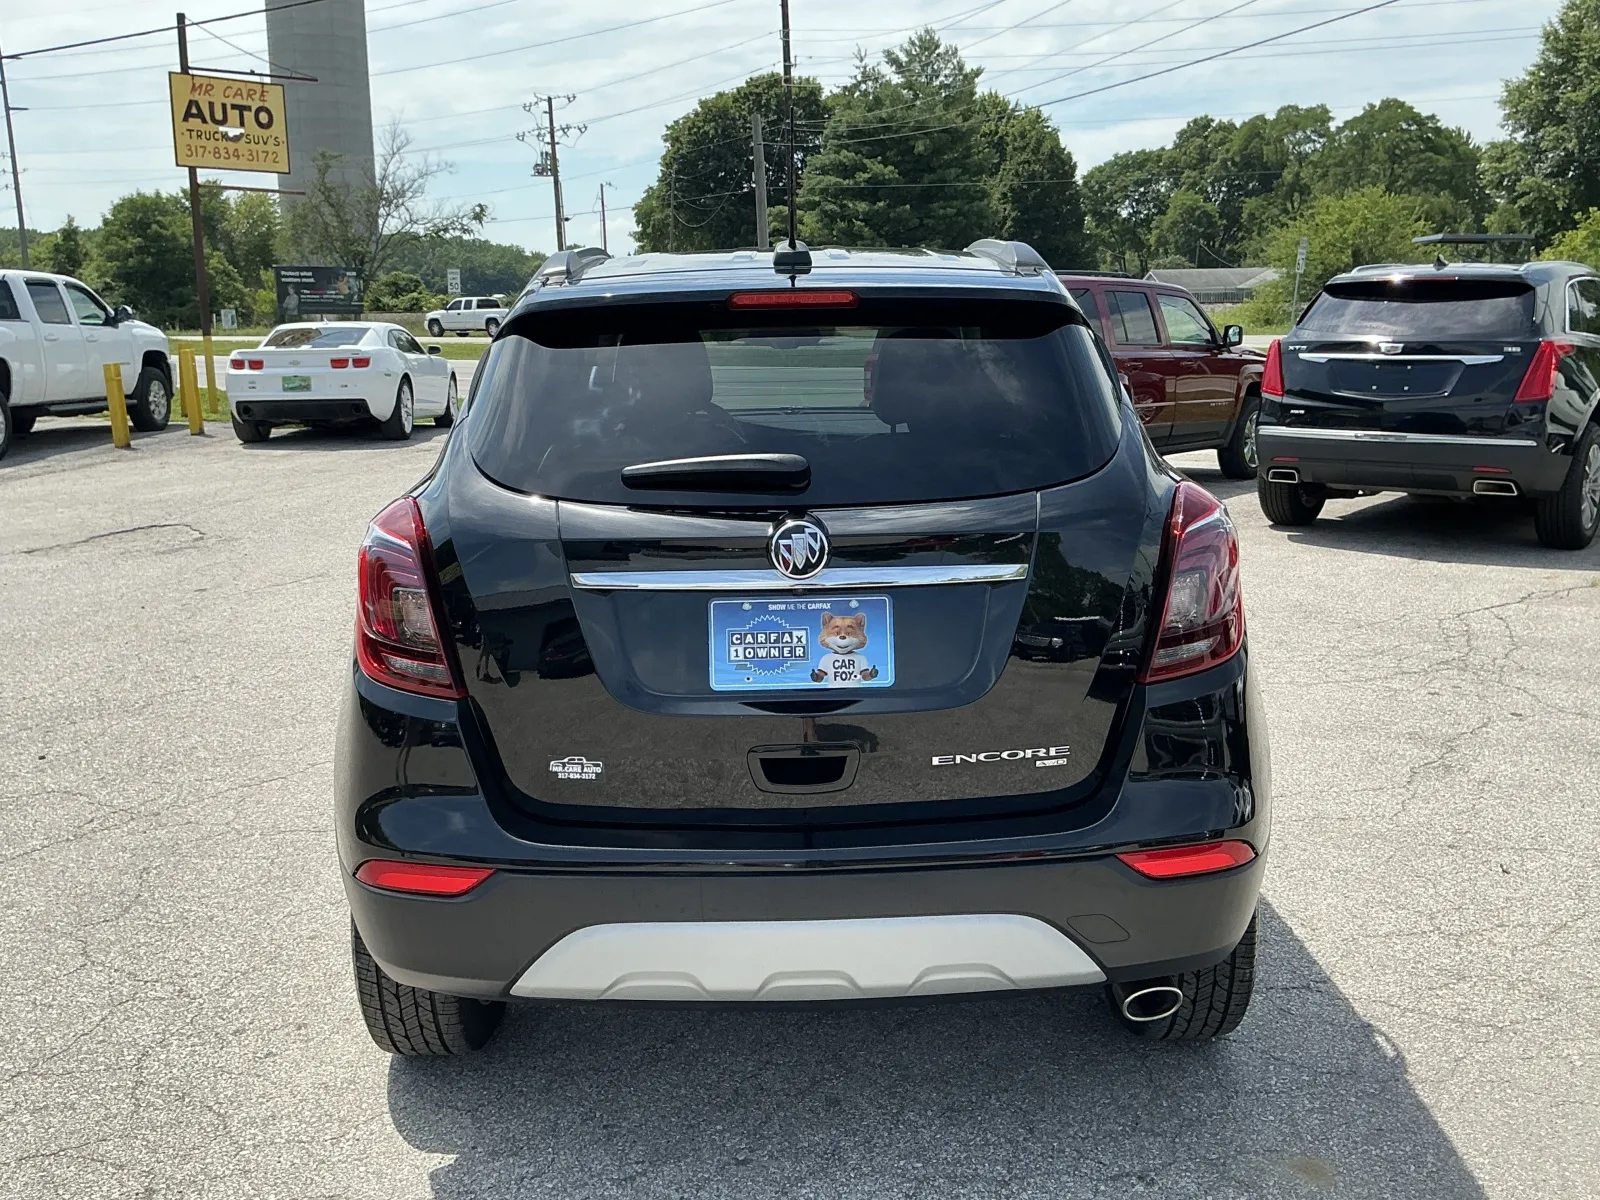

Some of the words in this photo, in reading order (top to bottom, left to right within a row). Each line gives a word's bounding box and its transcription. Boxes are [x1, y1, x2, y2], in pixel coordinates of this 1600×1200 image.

[223, 86, 269, 103] CARE
[182, 99, 274, 130] AUTO
[244, 133, 280, 147] SUV'S
[449, 282, 459, 290] 50
[768, 603, 786, 611] SHOW
[787, 603, 796, 611] ME
[807, 602, 831, 610] CARFAX
[731, 632, 806, 645] CARFAX
[832, 659, 855, 670] CAR
[931, 745, 1070, 766] ENCORE
[1036, 758, 1067, 767] AWD
